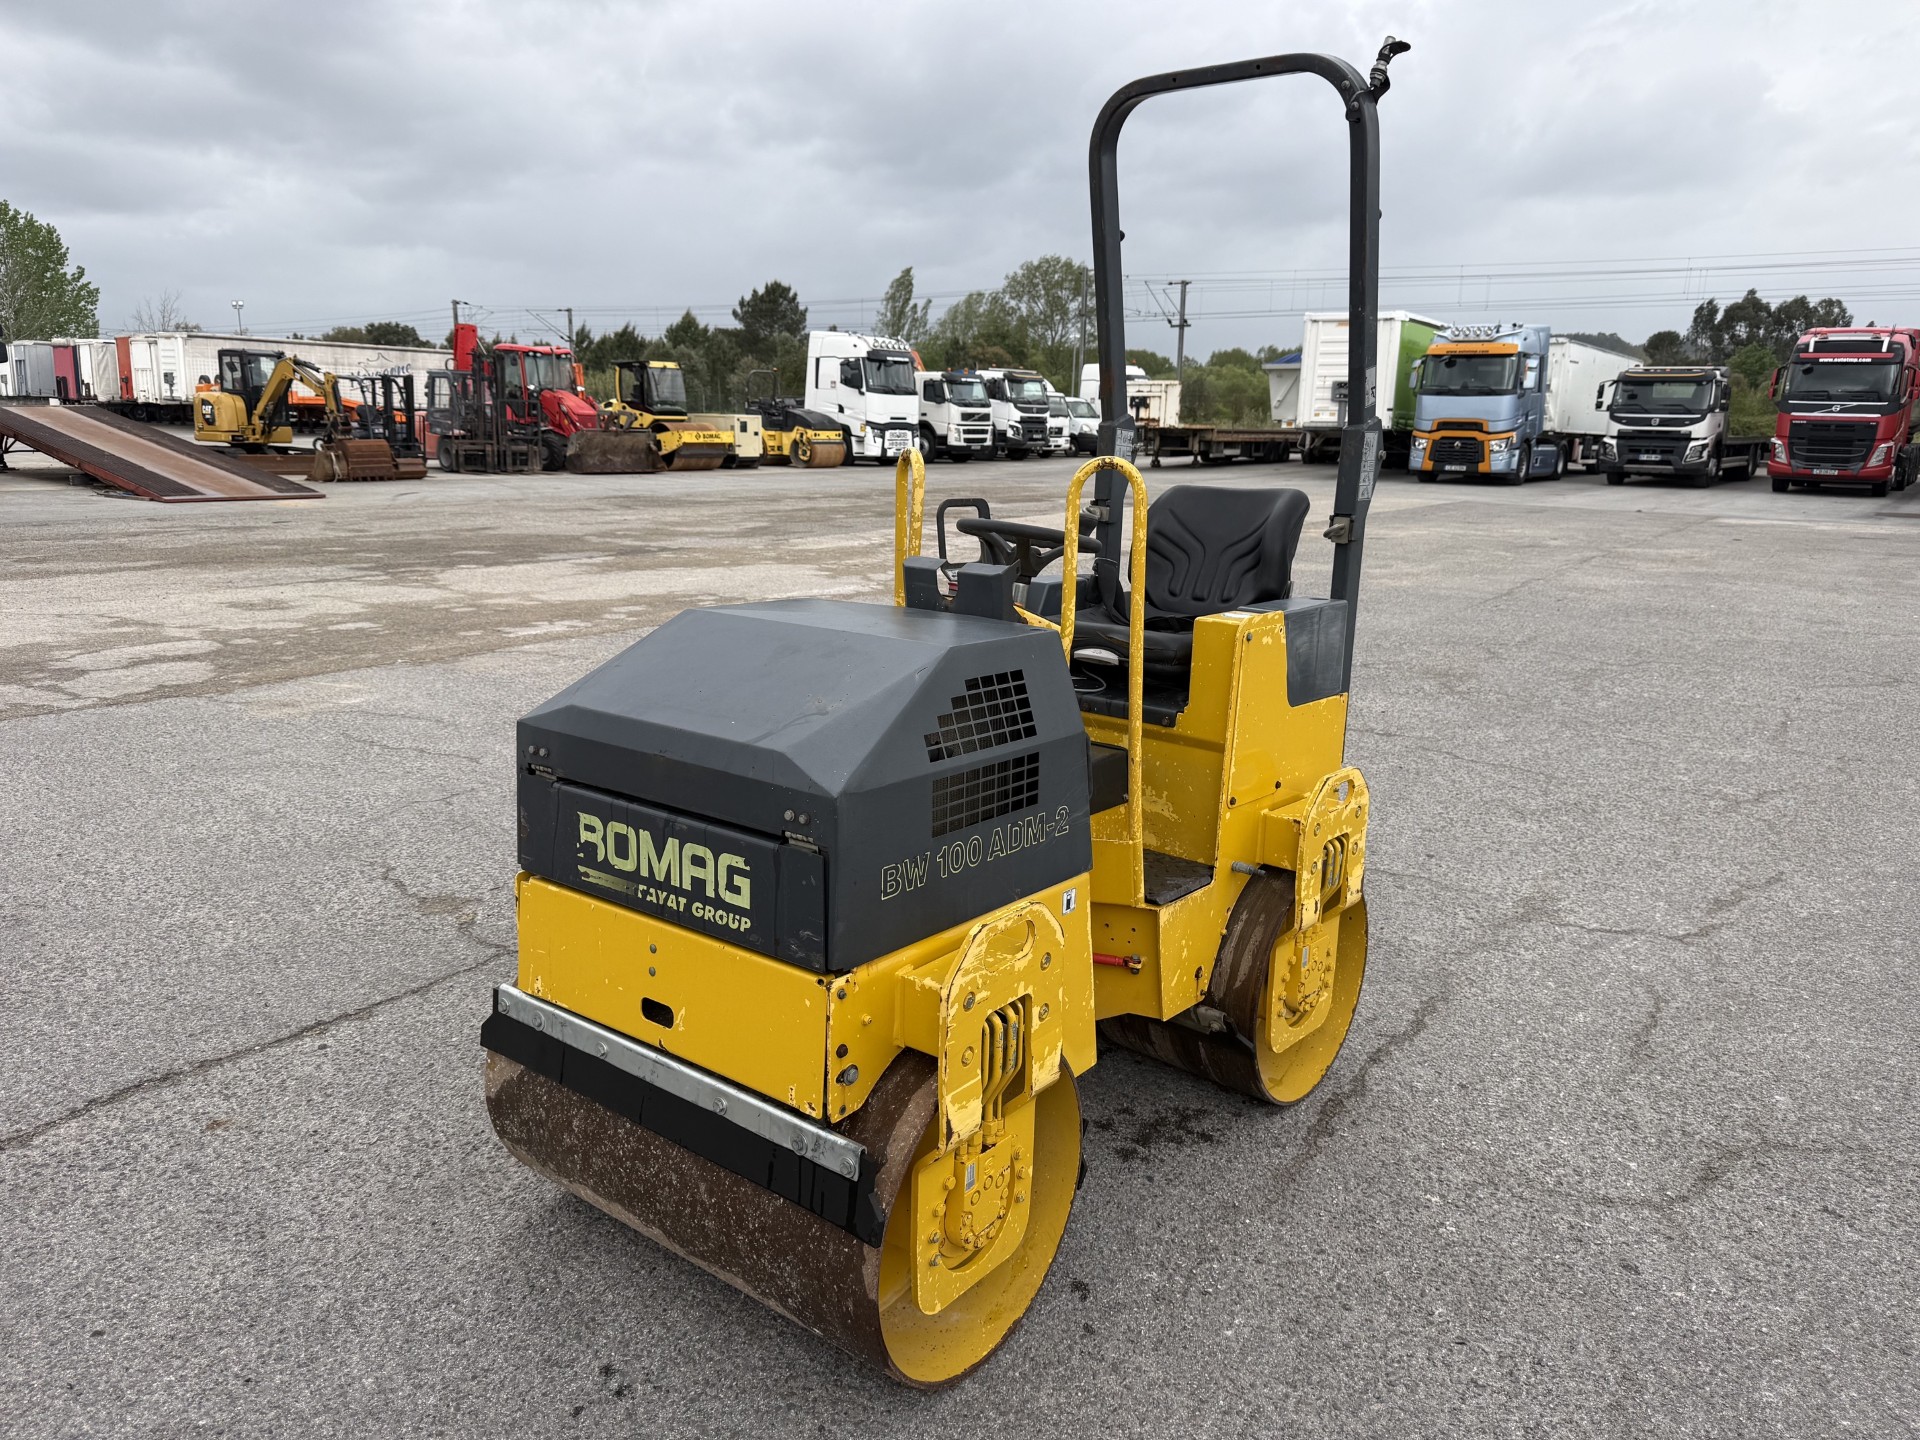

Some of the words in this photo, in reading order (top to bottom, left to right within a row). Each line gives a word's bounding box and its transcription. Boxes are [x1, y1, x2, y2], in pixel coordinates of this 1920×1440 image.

[577, 811, 750, 909] BOMAG
[881, 852, 930, 900] BW
[936, 835, 983, 878] 100
[987, 805, 1070, 862] ADM-2
[691, 902, 751, 932] GROUP
